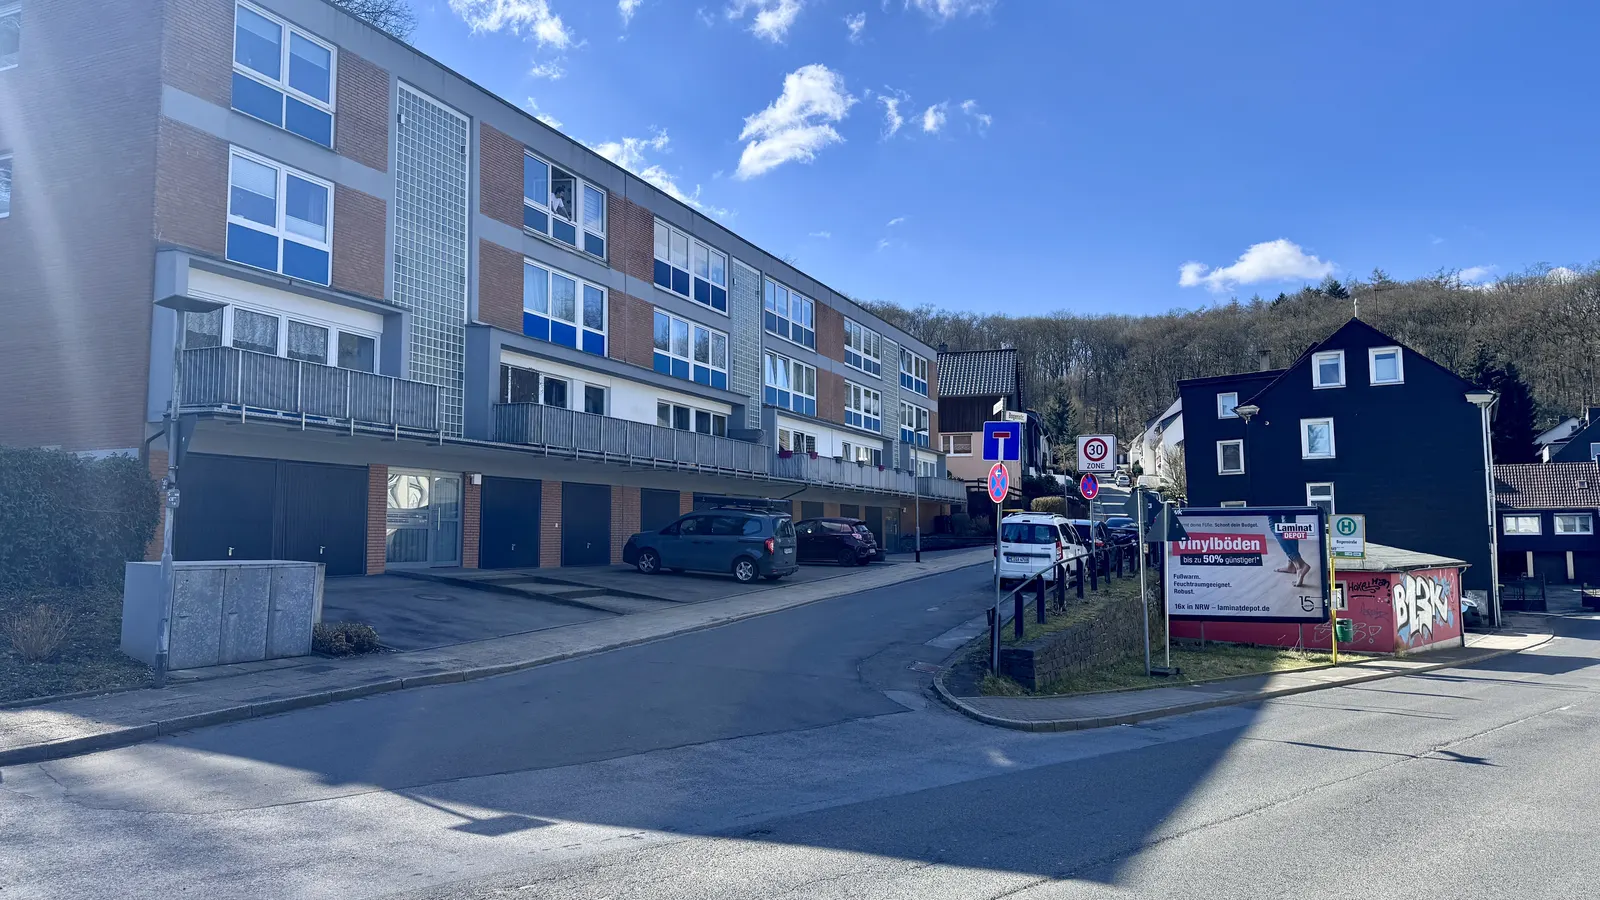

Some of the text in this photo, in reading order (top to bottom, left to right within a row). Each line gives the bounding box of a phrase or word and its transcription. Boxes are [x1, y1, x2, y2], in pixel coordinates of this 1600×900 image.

[1088, 444, 1102, 455] 30
[1342, 522, 1352, 532] H
[1203, 554, 1224, 564] 50%
[1299, 596, 1314, 612] 15
